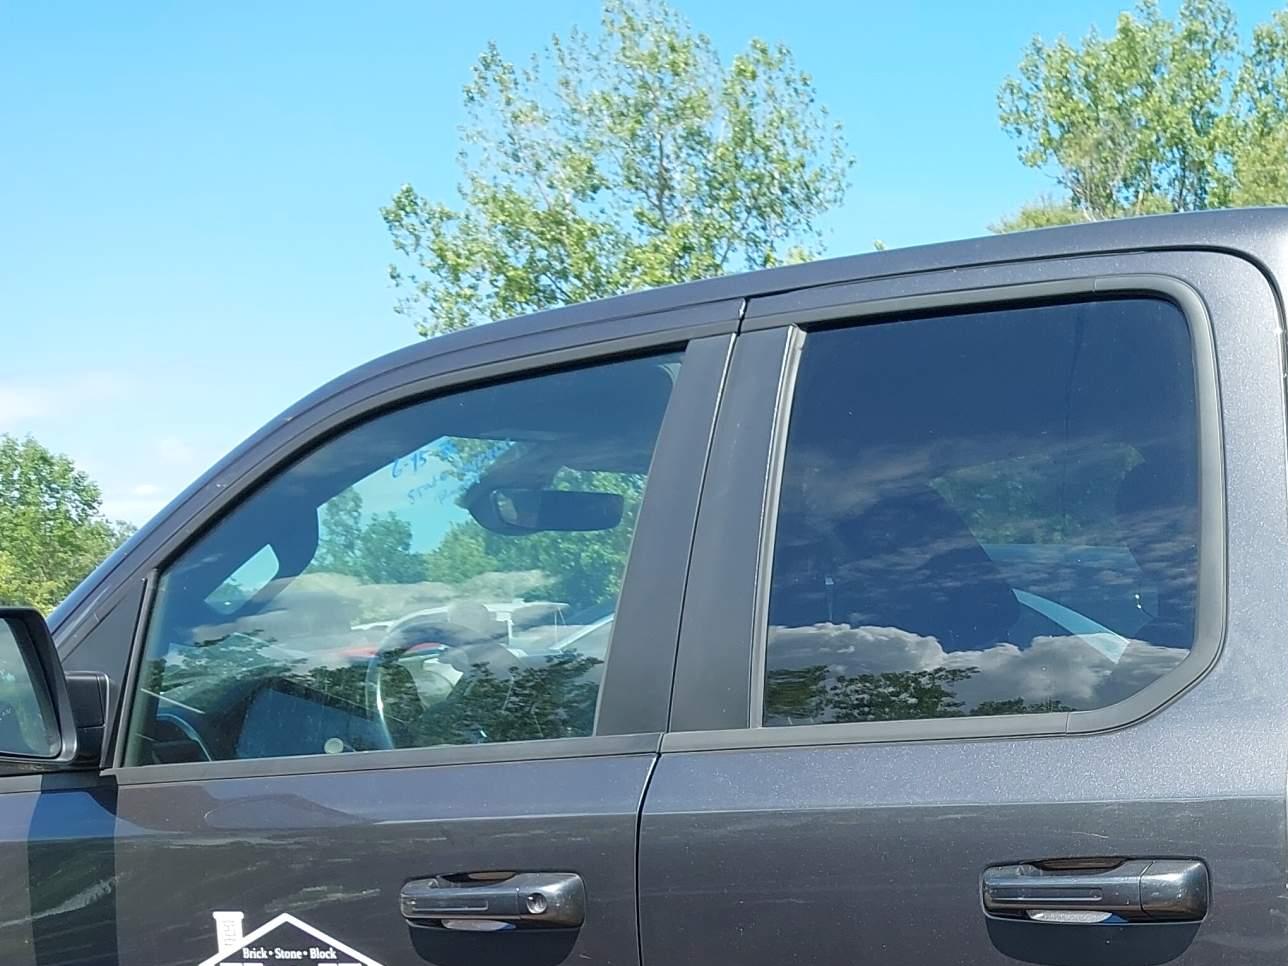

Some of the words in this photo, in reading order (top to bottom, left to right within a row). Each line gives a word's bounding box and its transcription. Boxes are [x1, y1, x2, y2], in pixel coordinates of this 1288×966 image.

[242, 947, 268, 959] Brick
[274, 948, 303, 960] Stone
[309, 948, 338, 960] Block
